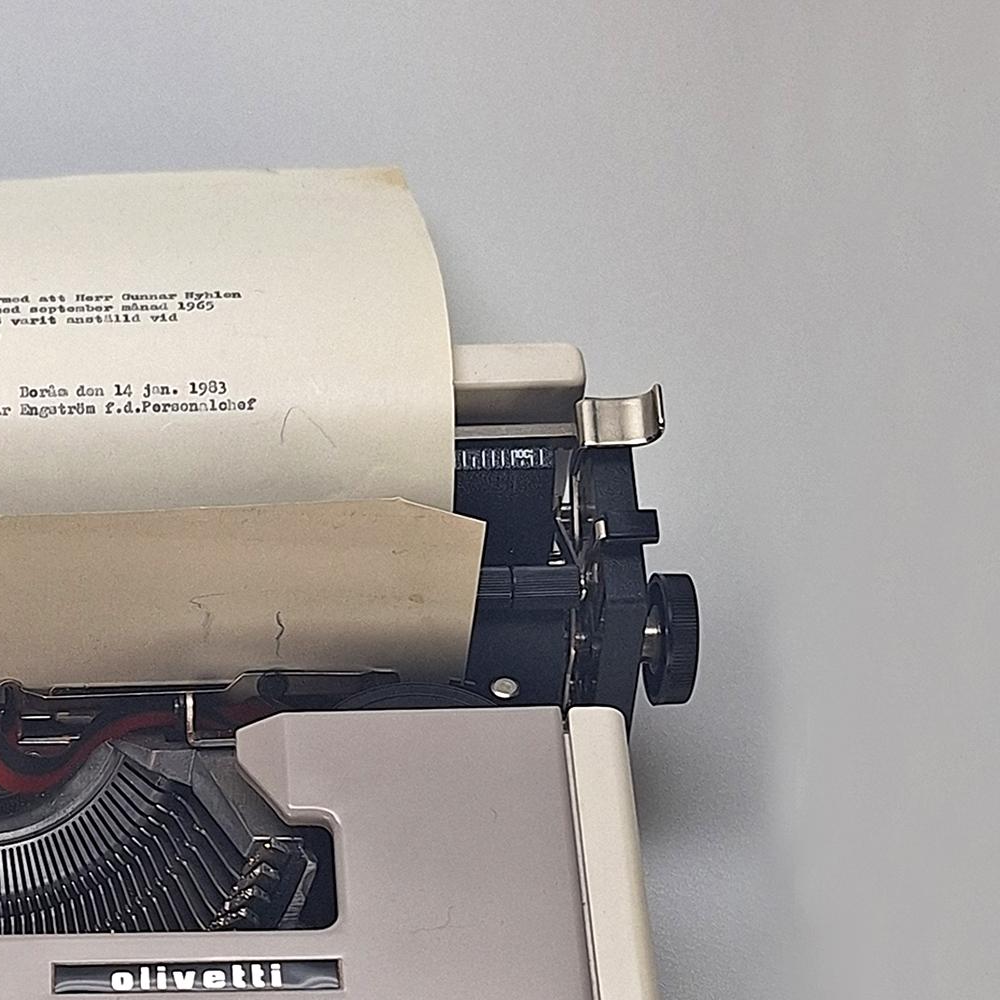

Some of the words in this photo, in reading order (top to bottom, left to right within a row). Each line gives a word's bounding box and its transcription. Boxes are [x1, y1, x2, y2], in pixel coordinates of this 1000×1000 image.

[38, 294, 66, 303] att
[75, 293, 114, 302] Herr
[121, 293, 178, 301] Gunnar
[29, 303, 115, 315] september
[121, 302, 169, 312] månad
[177, 299, 215, 312] 1965
[10, 315, 57, 326] varit
[65, 312, 142, 325] anställd
[149, 312, 179, 323] vid
[75, 384, 105, 398] den
[113, 383, 133, 398] 14
[142, 383, 179, 398] jan.
[188, 380, 228, 396] 1983
[19, 402, 96, 419] Engström
[110, 963, 282, 991] olivetti
